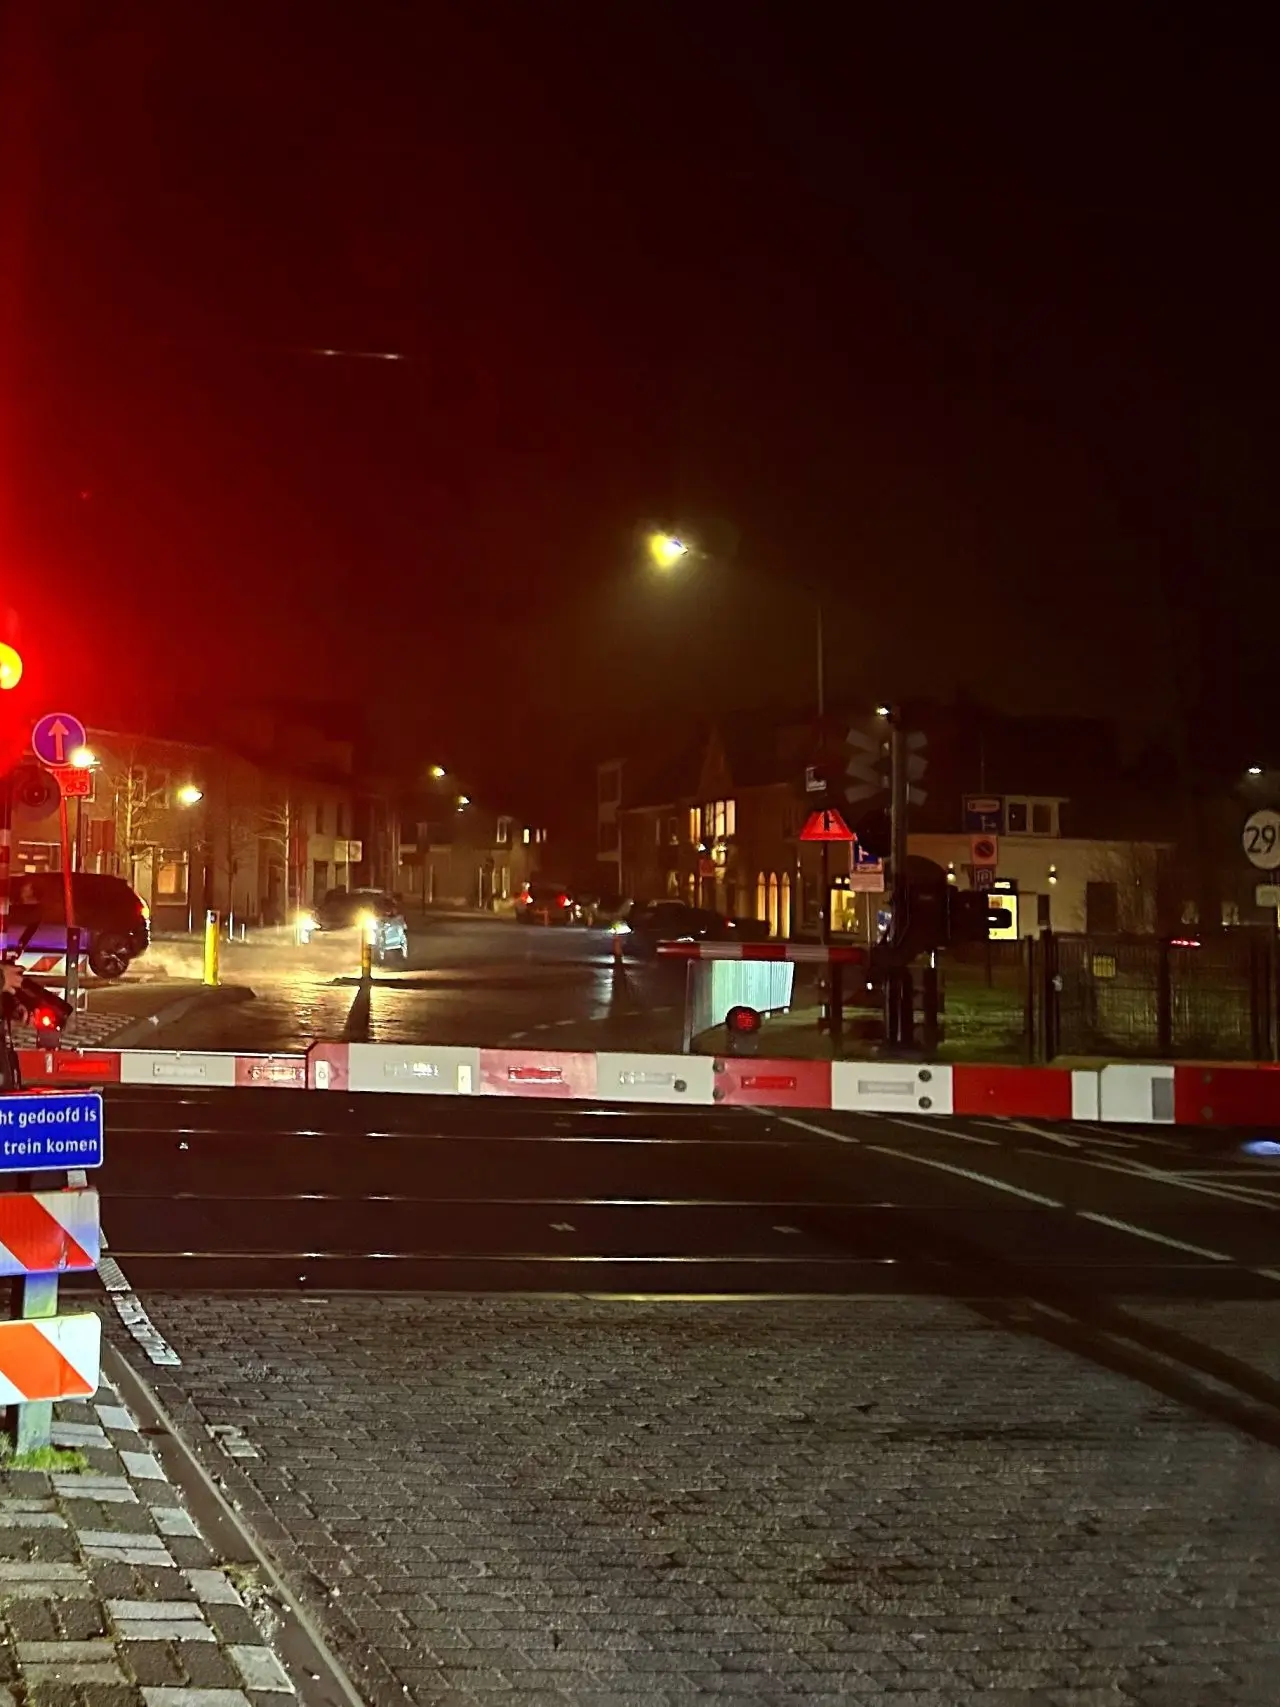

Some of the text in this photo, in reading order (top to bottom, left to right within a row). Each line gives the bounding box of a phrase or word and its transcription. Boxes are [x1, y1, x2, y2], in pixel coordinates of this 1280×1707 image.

[18, 1106, 80, 1128] gedoofd
[84, 1106, 97, 1122] is
[4, 1138, 42, 1156] trein
[46, 1138, 98, 1153] komen
